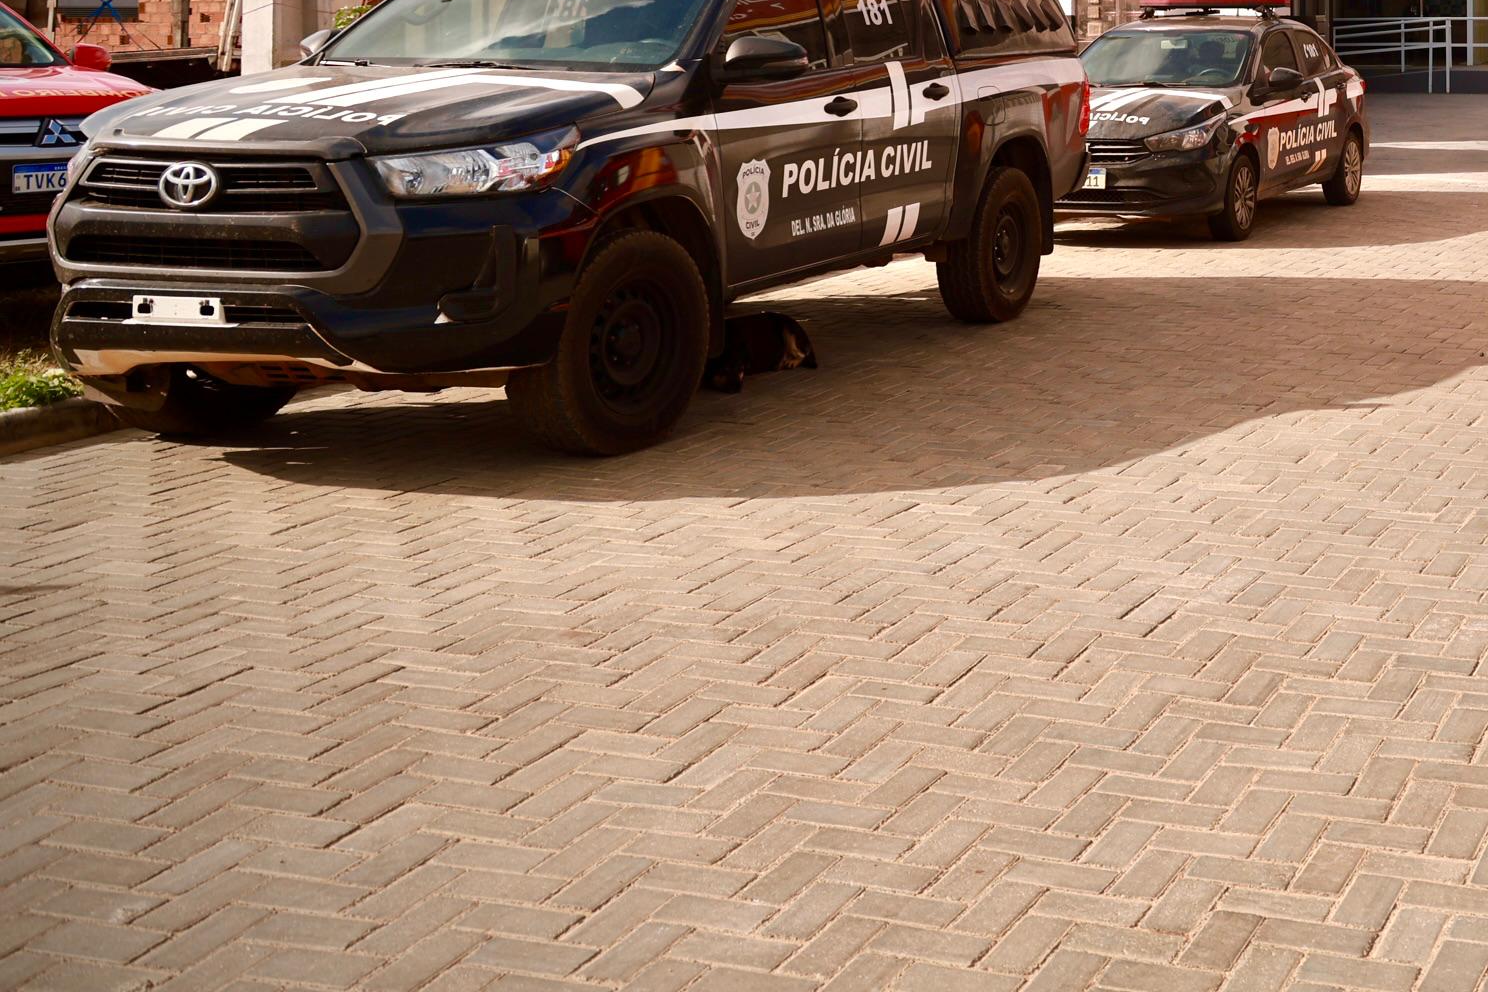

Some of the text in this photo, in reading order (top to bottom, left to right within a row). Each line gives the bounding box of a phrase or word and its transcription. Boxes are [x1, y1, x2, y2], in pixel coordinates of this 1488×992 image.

[1280, 119, 1338, 152] POLÍCIA CIVIL
[23, 172, 68, 189] TVK6
[742, 165, 765, 179] POLÍCIA
[782, 140, 932, 198] POLÍCIA CIVIL
[745, 219, 761, 230] CIVIL
[791, 220, 805, 236] DEL.
[812, 215, 825, 231] SRA.
[827, 213, 834, 228] DA
[835, 205, 855, 225] GLÓRIA
